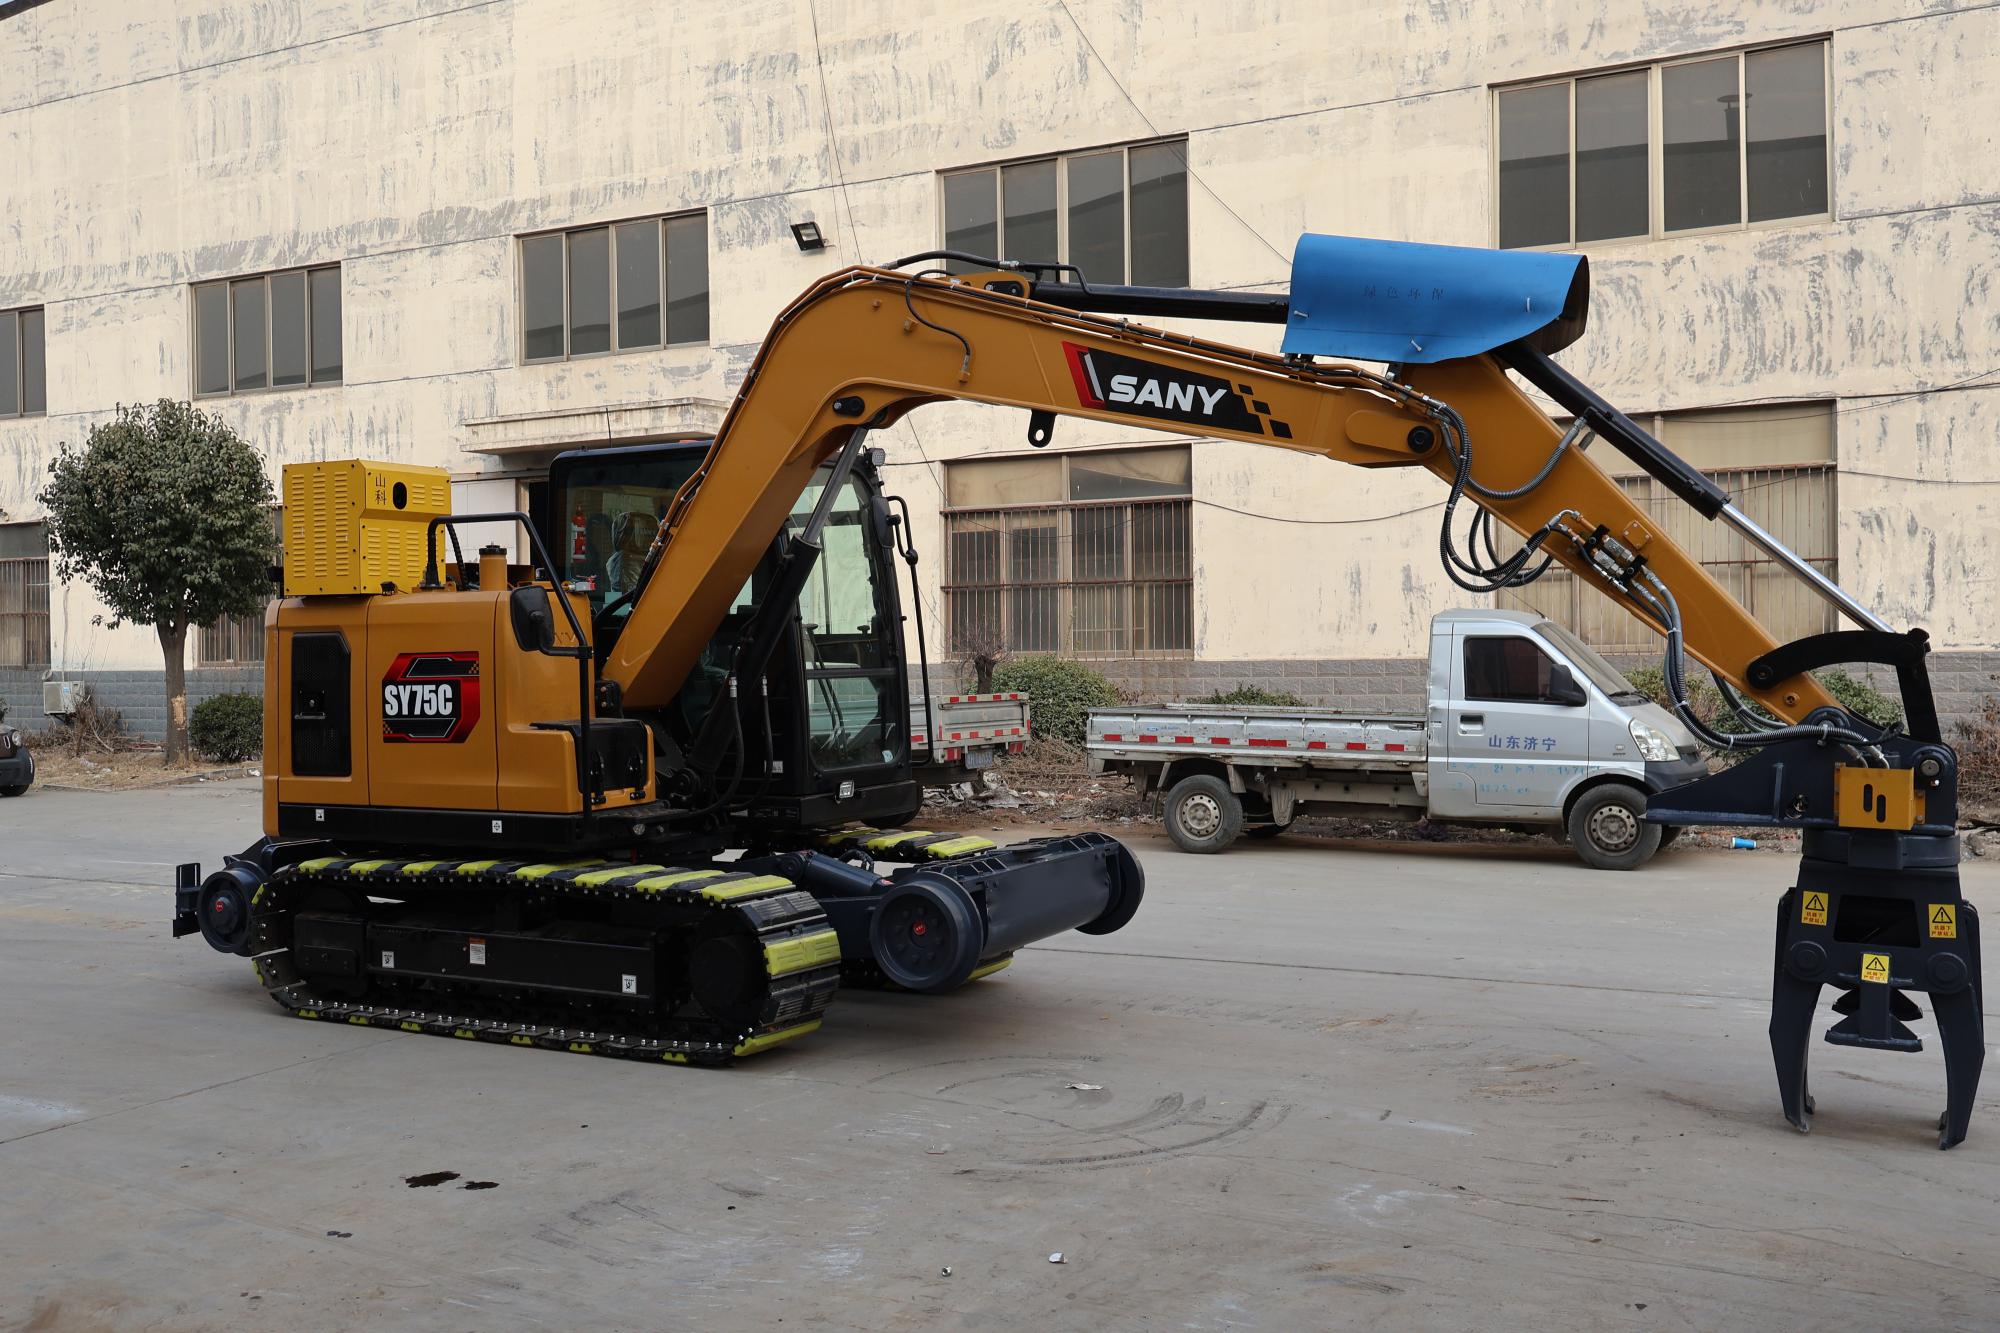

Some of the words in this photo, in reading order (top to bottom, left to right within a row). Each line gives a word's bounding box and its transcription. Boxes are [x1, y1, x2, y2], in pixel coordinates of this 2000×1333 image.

[1108, 374, 1228, 415] SANY
[384, 684, 453, 716] SY75C
[1488, 734, 1557, 751] 山东济宁
